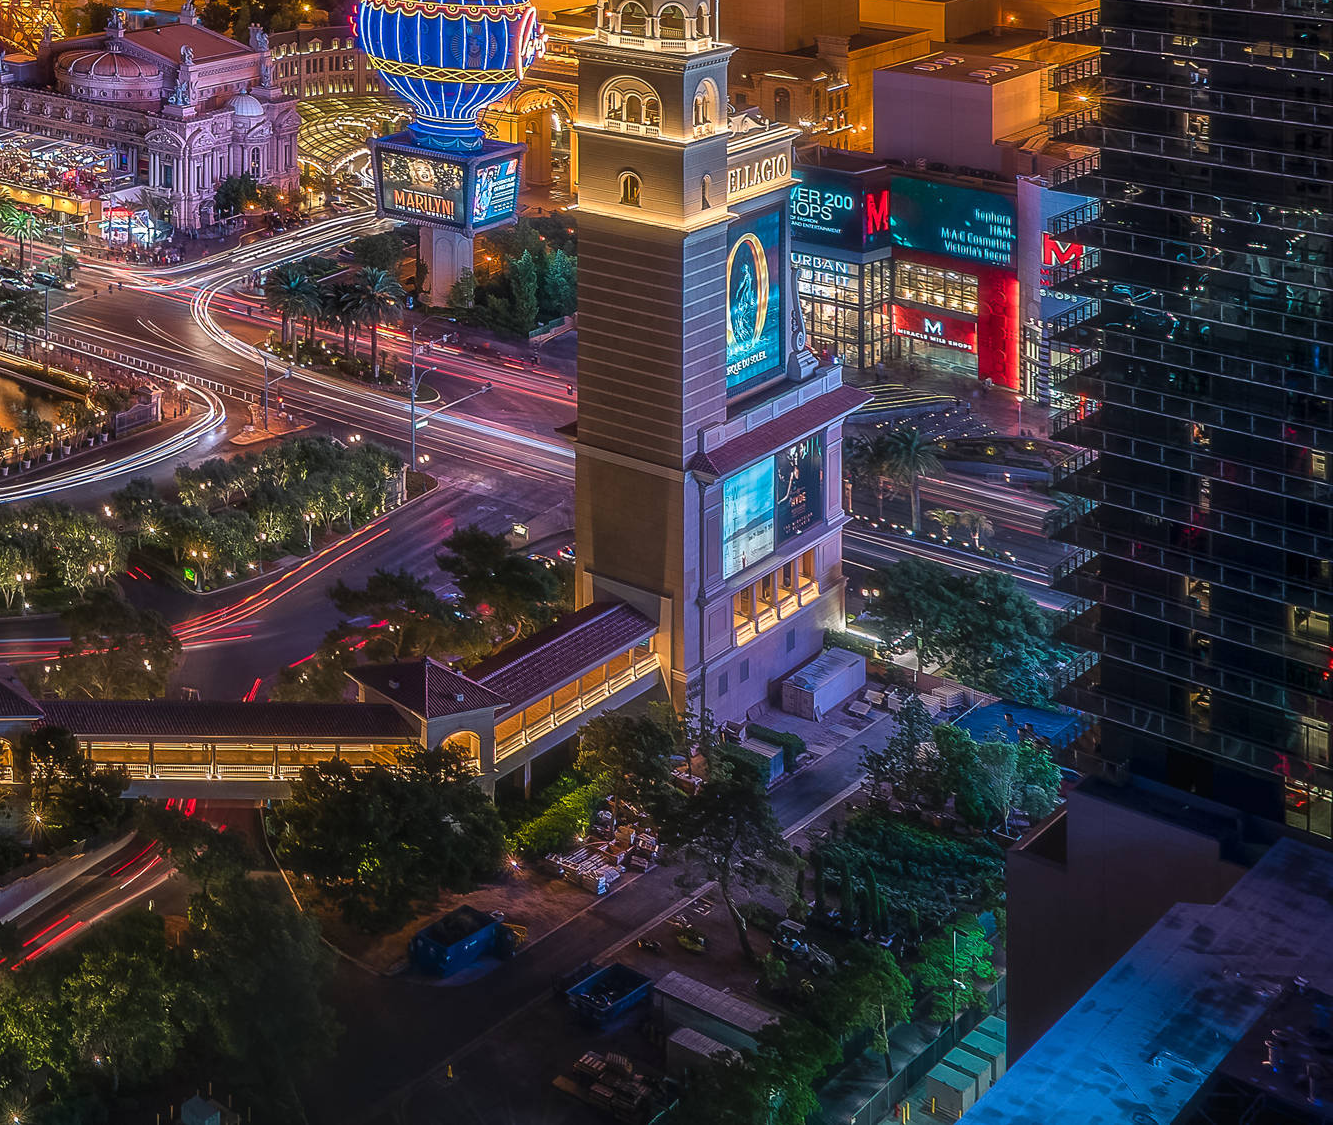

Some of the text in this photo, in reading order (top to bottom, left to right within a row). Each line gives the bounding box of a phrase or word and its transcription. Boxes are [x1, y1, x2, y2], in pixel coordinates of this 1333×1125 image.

[728, 154, 787, 193] ELLAGIO
[394, 189, 455, 215] MARILYN!
[791, 200, 832, 221] HOPS
[824, 193, 854, 210] 200
[426, 210, 455, 221] MUSICAL
[866, 190, 890, 235] M
[975, 208, 1011, 226] Sephora
[791, 253, 846, 273] URBAN
[1039, 288, 1078, 303] SHOPS
[924, 317, 943, 336] M
[897, 328, 973, 350] MIRACLE MILE SHOPS
[725, 361, 742, 376] IRQUE
[750, 350, 768, 365] SOLEIL
